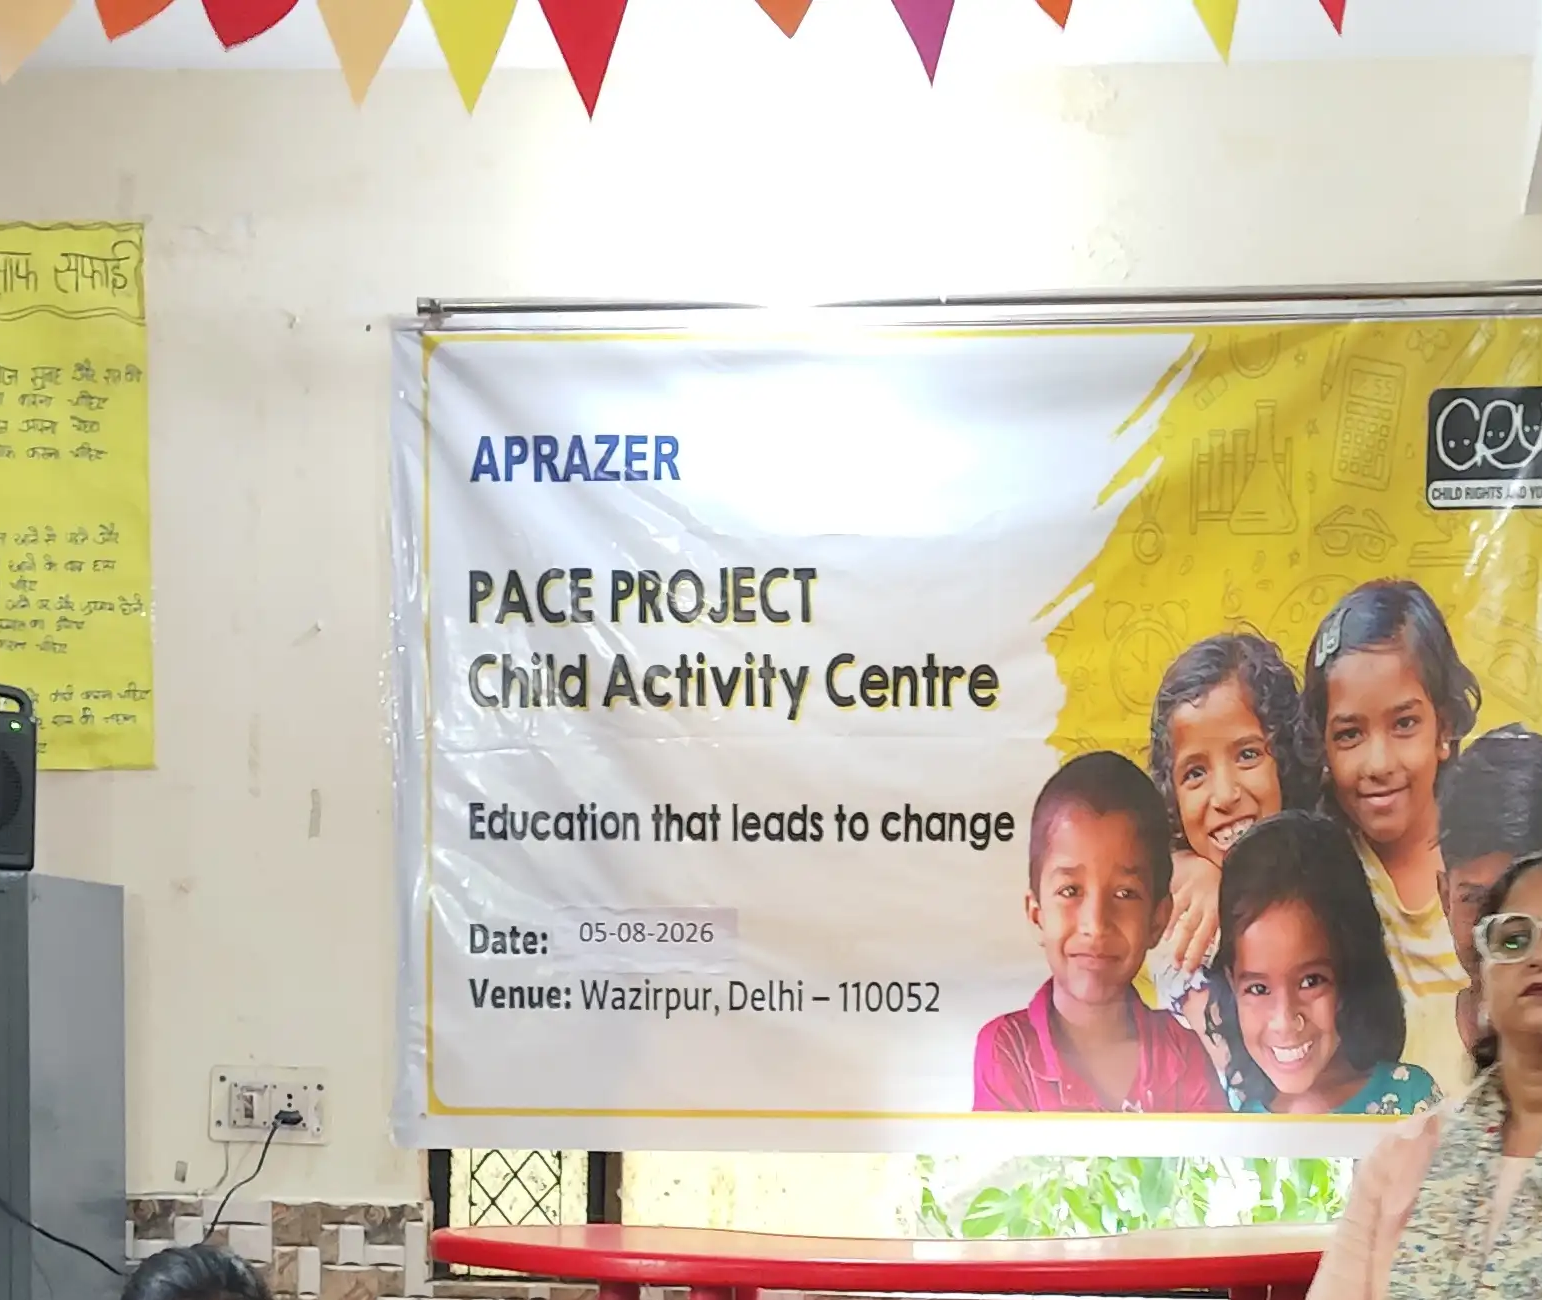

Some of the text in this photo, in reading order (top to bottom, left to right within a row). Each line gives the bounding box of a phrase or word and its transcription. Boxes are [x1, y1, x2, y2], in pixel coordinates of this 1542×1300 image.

[54, 240, 143, 297] सफाई
[470, 434, 681, 483] APRAZER
[1432, 486, 1462, 501] CHILD
[1465, 486, 1503, 500] RIGHTS
[1506, 486, 1527, 500] AD
[468, 566, 818, 625] PACE PROJECT
[467, 650, 1001, 721] Child Activity Centre
[468, 801, 1016, 851] Education that leads to change
[468, 921, 715, 955] Date: 05-08-2026
[468, 977, 572, 1010] Venue:
[581, 979, 721, 1019] Wazirpur,
[728, 979, 804, 1013] Delhi
[839, 980, 941, 1013] 110052
